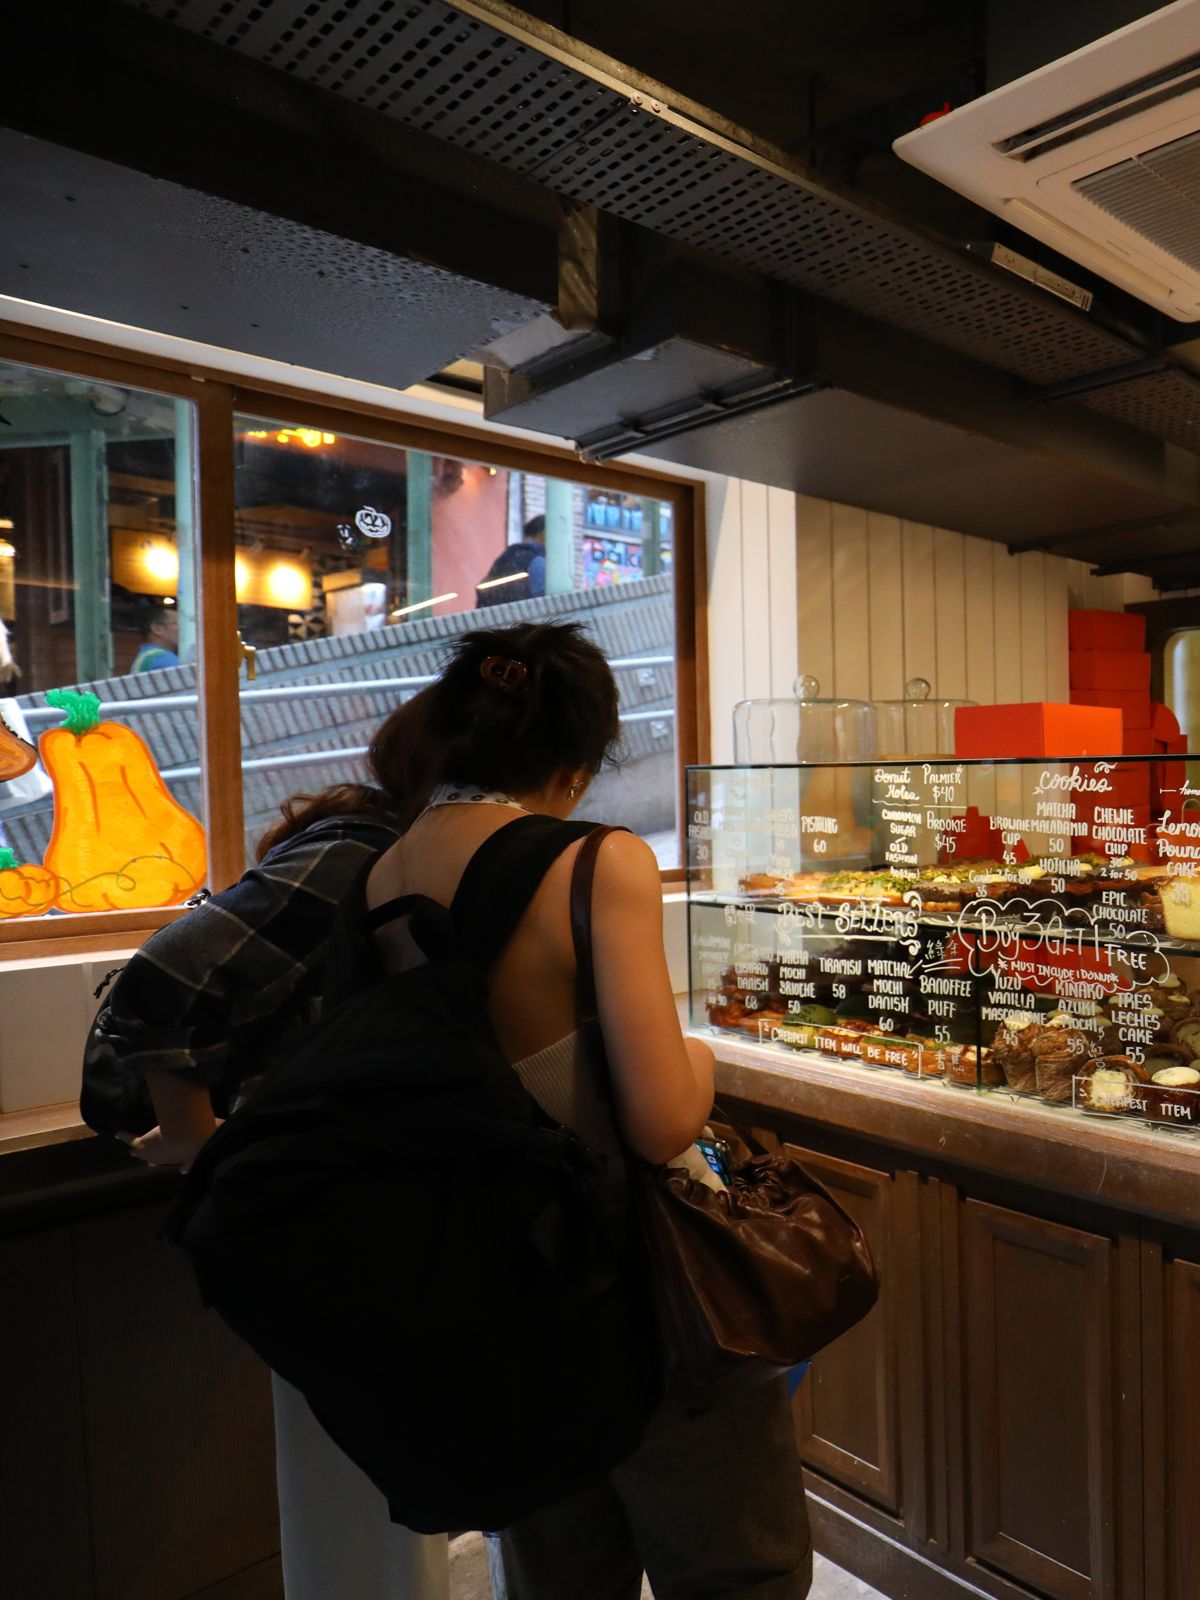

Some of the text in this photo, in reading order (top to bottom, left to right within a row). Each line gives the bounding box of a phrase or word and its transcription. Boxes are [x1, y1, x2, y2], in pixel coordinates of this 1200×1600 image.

[874, 767, 911, 784] Donut
[922, 764, 961, 785] PALMIER
[1039, 765, 1112, 793] Cookies
[933, 786, 955, 803] $40
[1037, 802, 1076, 819] MATCHA
[1094, 806, 1134, 825] CHEWIE
[890, 822, 916, 837] SUGAR
[927, 811, 967, 832] BROOKIE
[989, 816, 1030, 831] BROWNIE
[1002, 831, 1020, 845] CUP
[1092, 825, 1147, 845] CHOCOLATE
[813, 839, 827, 853] 60
[889, 843, 908, 854] OLD
[934, 836, 956, 853] $45
[1049, 838, 1064, 852] 50
[1105, 843, 1128, 855] CHIP
[1003, 850, 1016, 865] 45
[1124, 868, 1138, 881] 50
[1166, 861, 1198, 877] CAKE
[1051, 878, 1065, 893] 50
[1102, 891, 1126, 906] EPIC
[777, 899, 918, 937] BEST SELLERS
[1092, 904, 1149, 924] CHOCOLATE
[1108, 923, 1125, 940] 50
[1022, 913, 1043, 950] 3
[1047, 916, 1085, 955] GET
[1104, 943, 1147, 971] FREE
[780, 967, 806, 980] MOCHI
[819, 957, 862, 975] TIRAMISU
[868, 959, 908, 978] MATCHA
[1011, 961, 1034, 973] MUST
[737, 977, 769, 992] DANISH
[873, 979, 903, 995] MOCHI
[919, 974, 972, 997] BANOFFEE
[991, 968, 1021, 990] YUZU
[832, 983, 846, 999] 58
[1055, 980, 1104, 999] KINAKO
[788, 1000, 800, 1014] 50
[868, 995, 909, 1014] DANISH
[988, 991, 1035, 1009] VANILLA
[1058, 999, 1096, 1016] AZUKI
[1116, 992, 1153, 1010] TRES
[928, 1000, 957, 1018] PUFF
[879, 1017, 894, 1032] 60
[1062, 1017, 1097, 1032] MOCHI
[1111, 1010, 1160, 1031] LECHES
[934, 1025, 950, 1044] 55
[1003, 1029, 1019, 1046] 45
[1119, 1027, 1154, 1045] CAKE
[841, 1042, 863, 1055] WILL
[867, 1048, 881, 1060] BE
[1126, 1047, 1145, 1064] 55
[1160, 1104, 1191, 1120] ITEM
